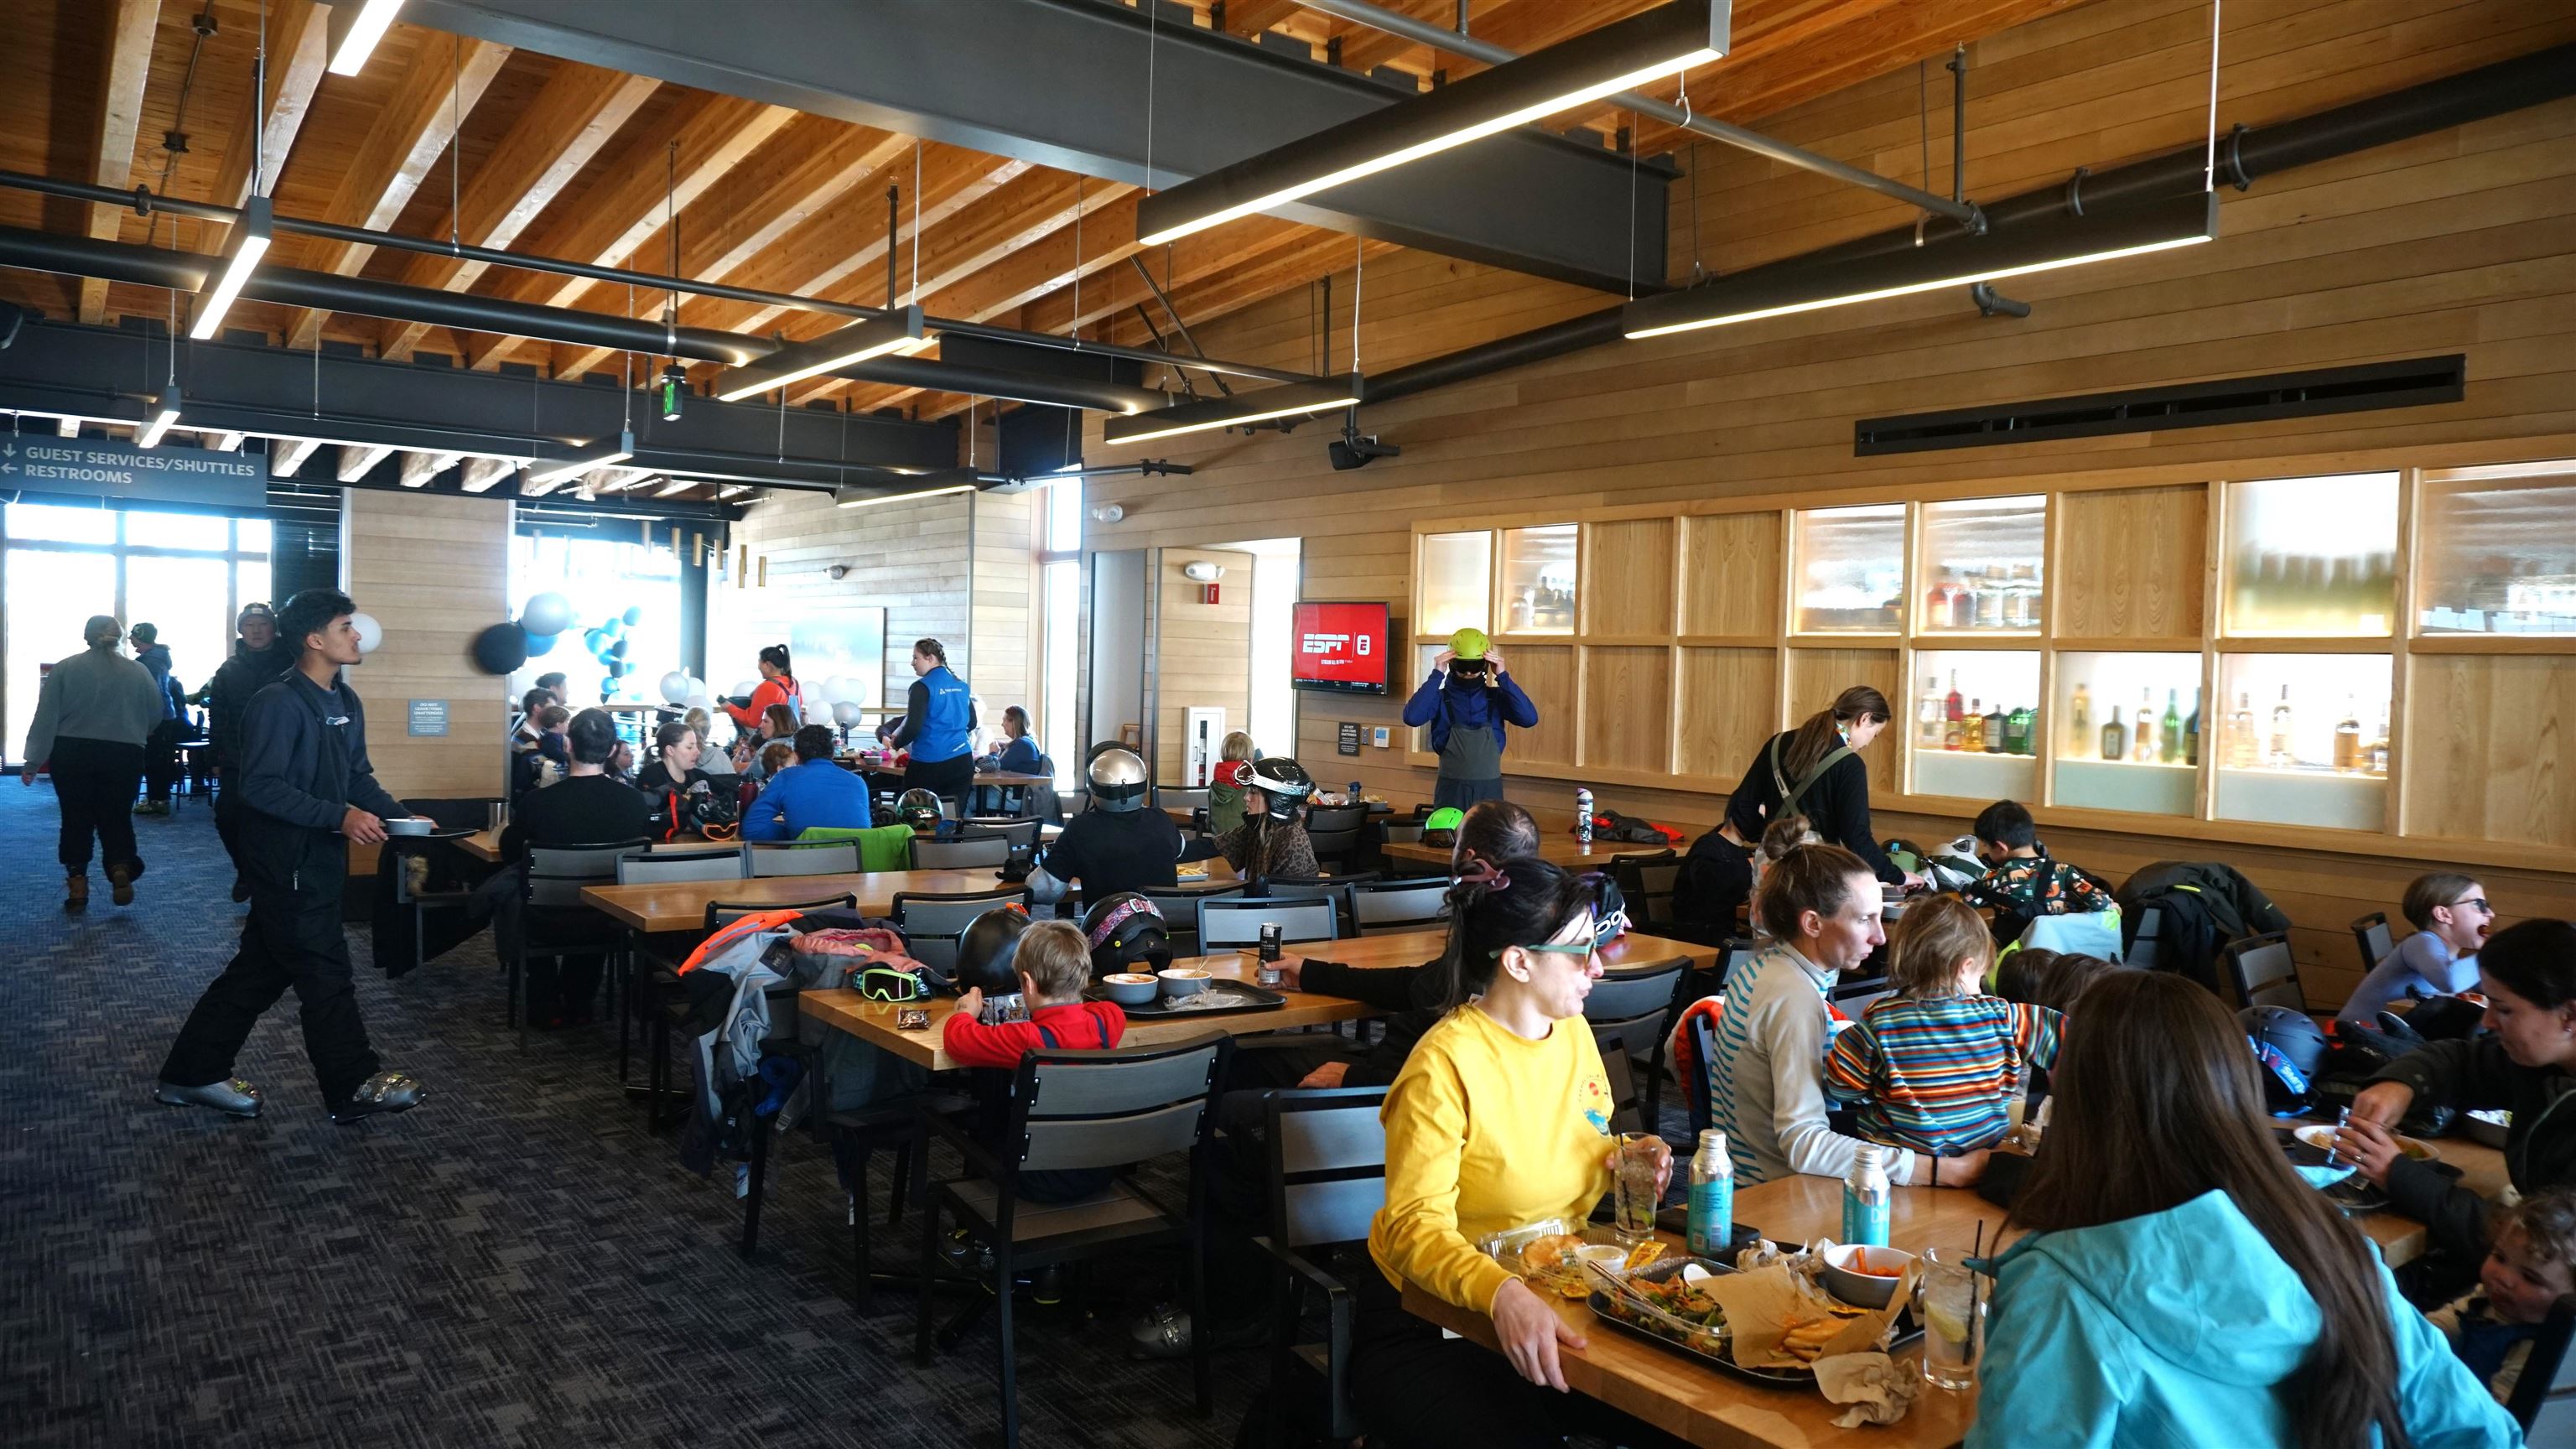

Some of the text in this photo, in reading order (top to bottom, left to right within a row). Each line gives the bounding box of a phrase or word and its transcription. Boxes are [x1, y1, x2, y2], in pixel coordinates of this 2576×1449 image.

[26, 447, 255, 476] GUEST SERVICES/SHUTTLES
[25, 464, 132, 484] RESTROOMS
[1302, 633, 1349, 653] ESPN
